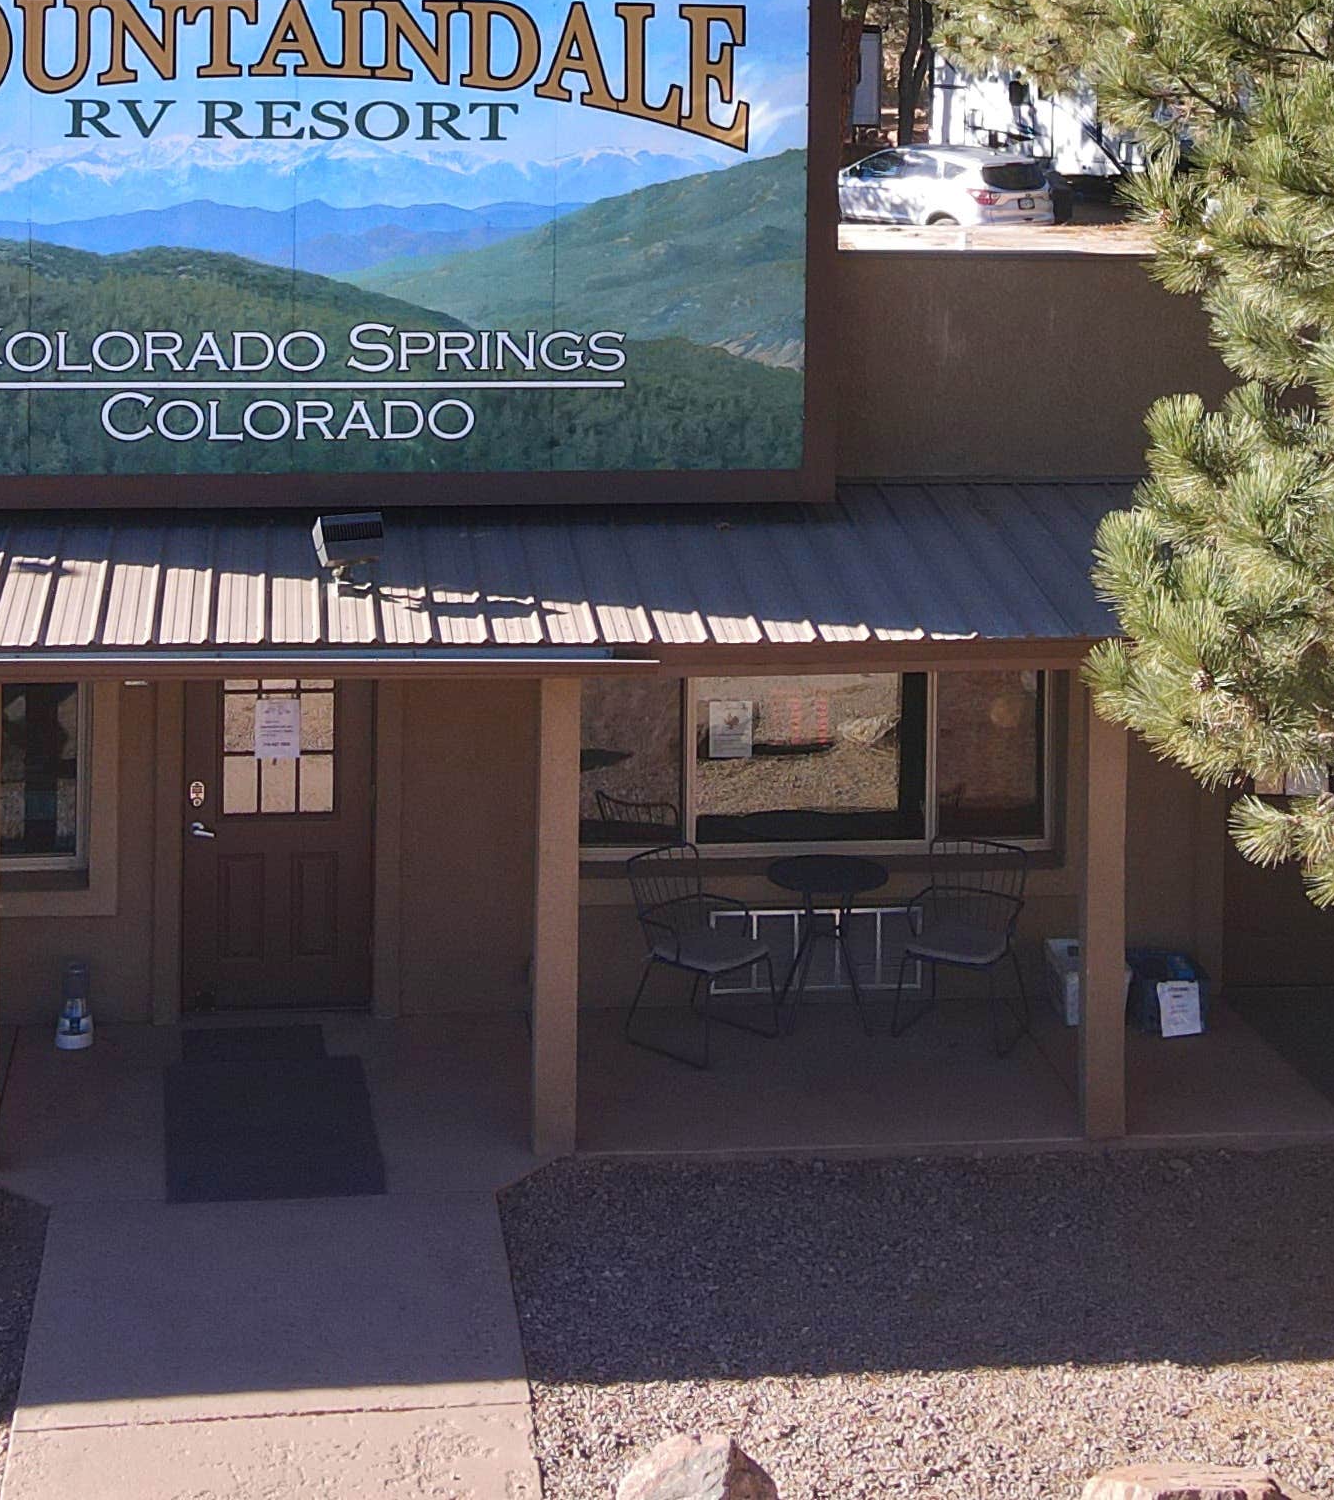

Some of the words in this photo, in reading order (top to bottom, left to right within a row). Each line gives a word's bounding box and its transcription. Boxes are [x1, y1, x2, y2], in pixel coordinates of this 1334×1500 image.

[64, 99, 176, 139] RV
[197, 100, 519, 142] RESORT
[347, 322, 627, 374] SPRINGS
[100, 391, 476, 442] COLORADO
